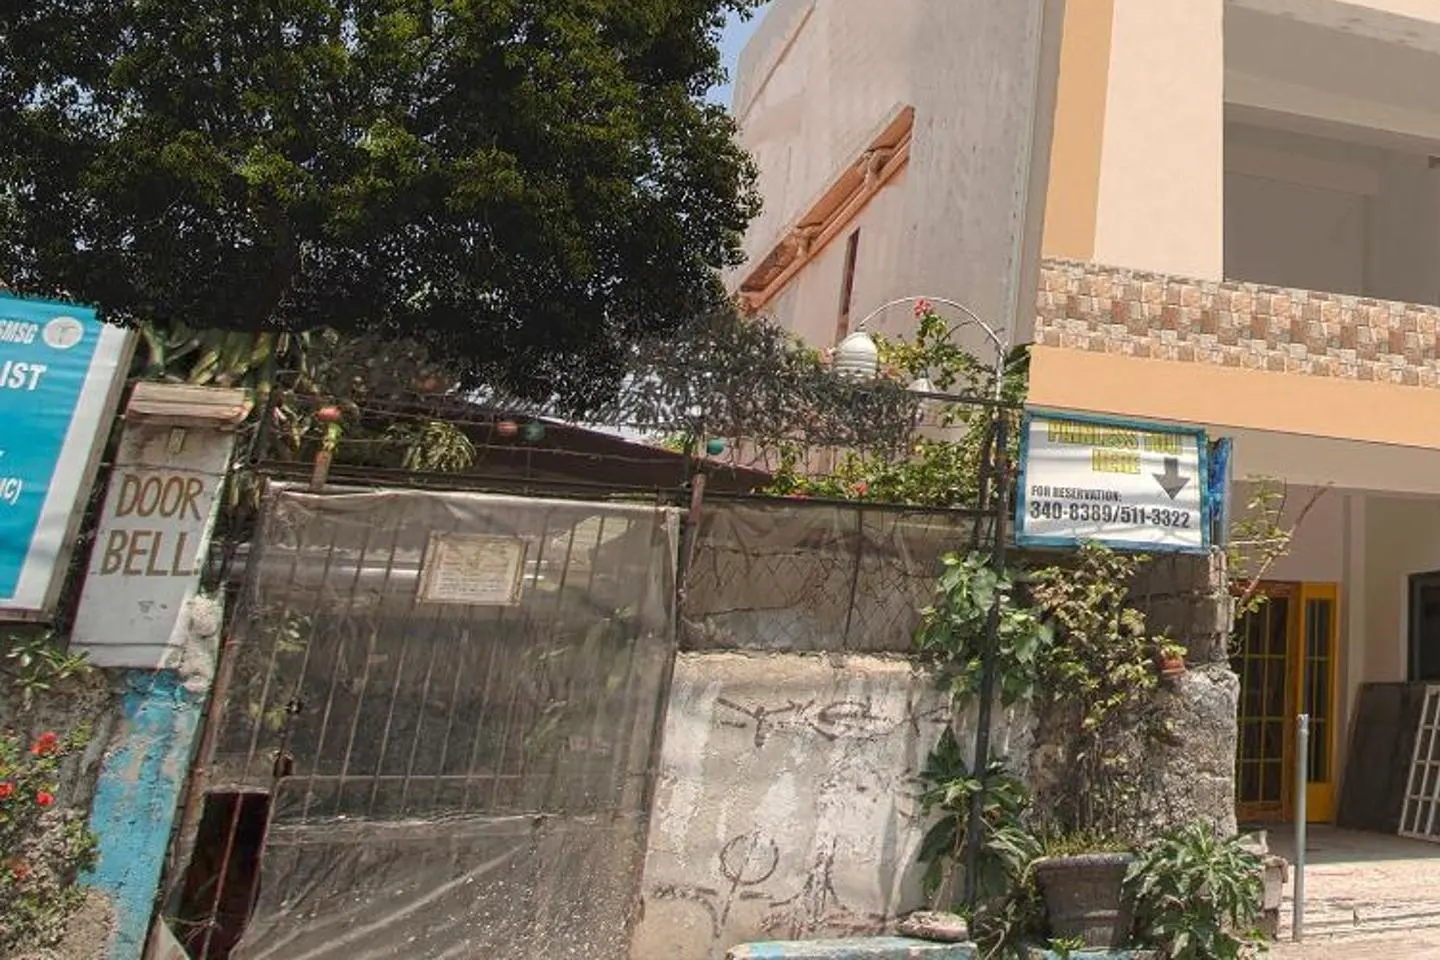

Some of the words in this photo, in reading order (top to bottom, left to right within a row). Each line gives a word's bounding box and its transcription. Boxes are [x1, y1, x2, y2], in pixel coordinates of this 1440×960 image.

[115, 473, 204, 521] DOOR
[1031, 485, 1051, 498] FOR
[1053, 487, 1122, 503] RESERVATION:
